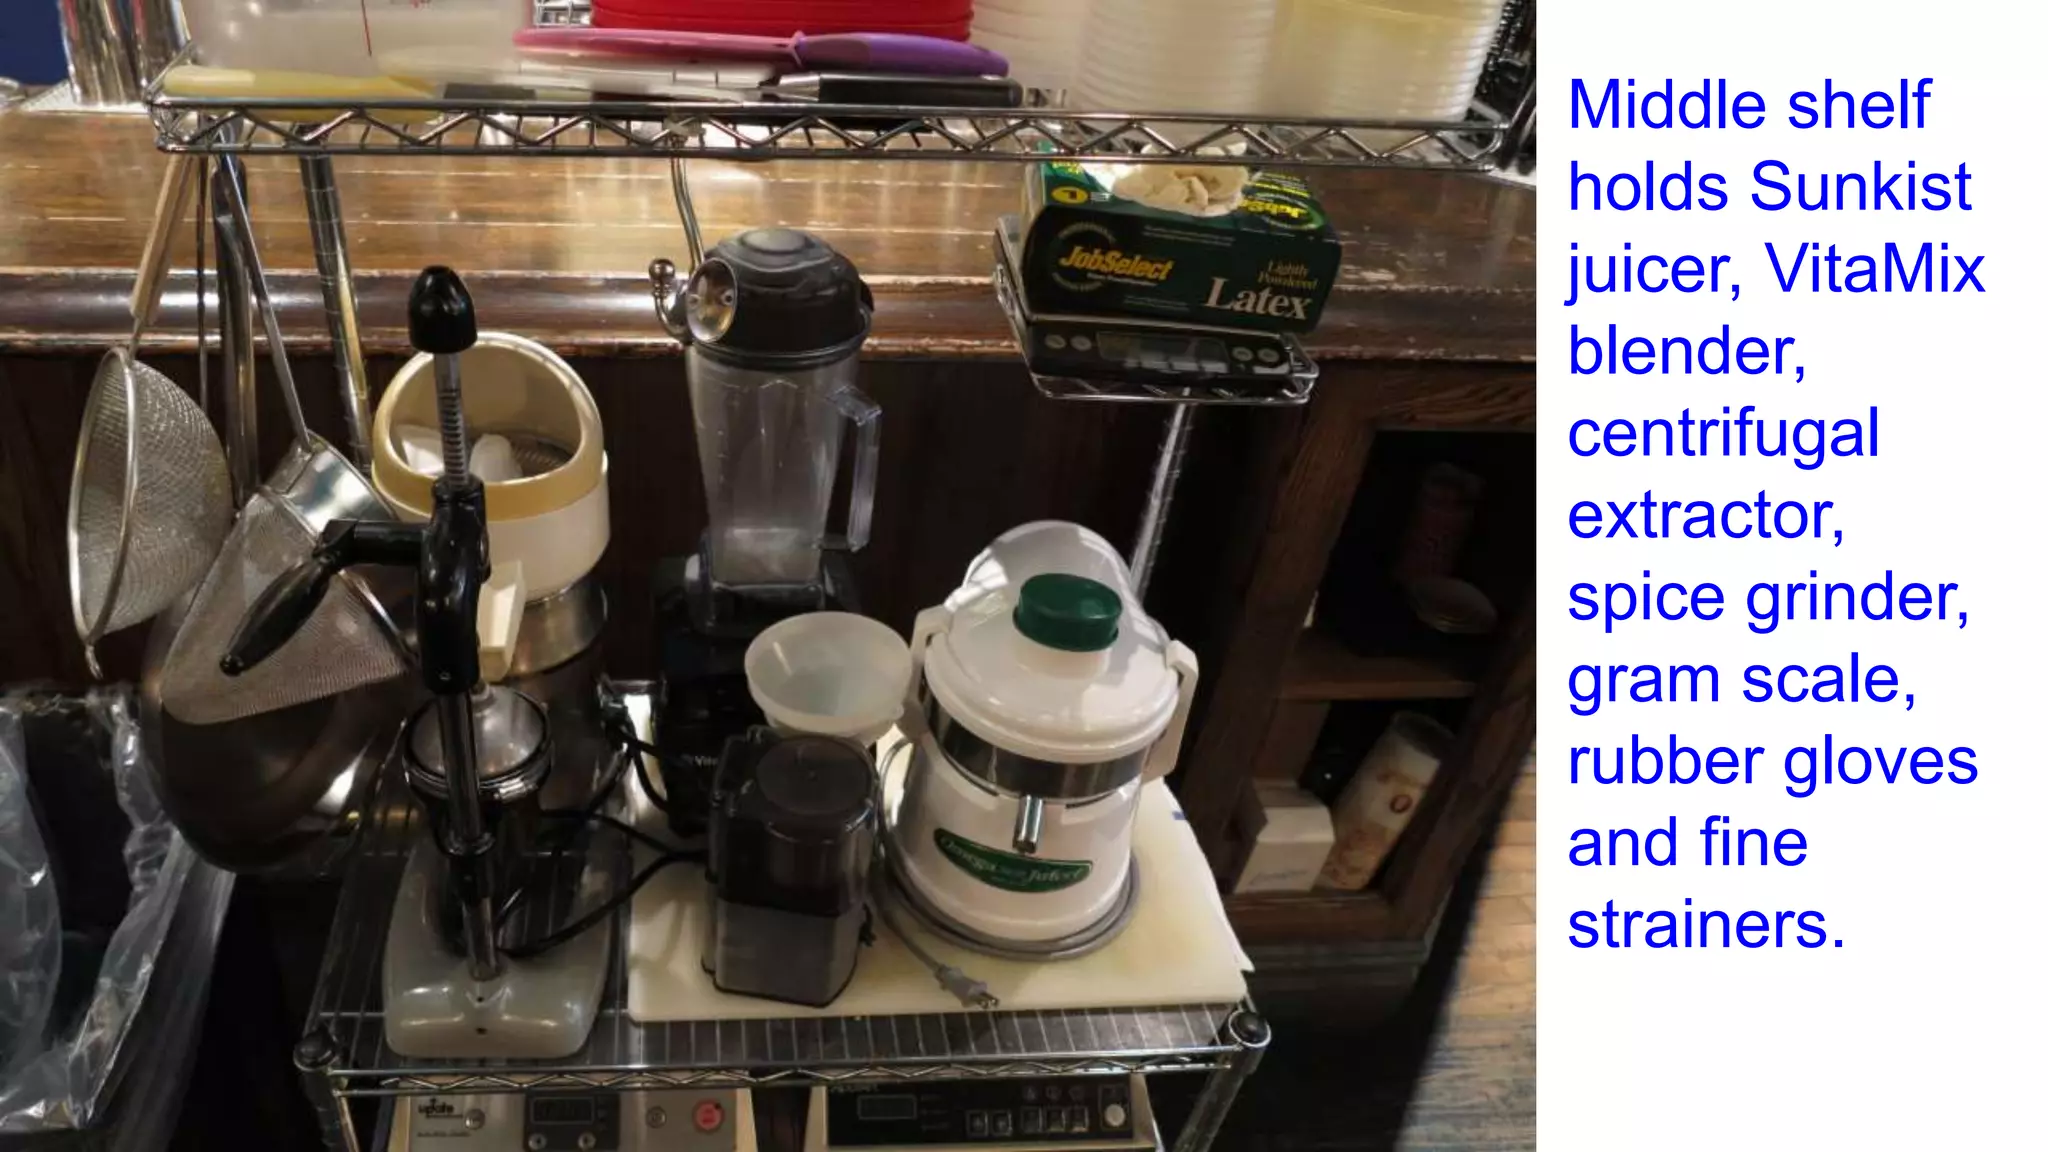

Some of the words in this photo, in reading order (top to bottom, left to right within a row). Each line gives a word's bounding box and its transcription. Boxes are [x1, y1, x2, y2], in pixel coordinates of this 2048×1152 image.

[1059, 246, 1174, 280] JobSelect
[1267, 259, 1309, 280] Lightly
[1203, 276, 1312, 320] Latex
